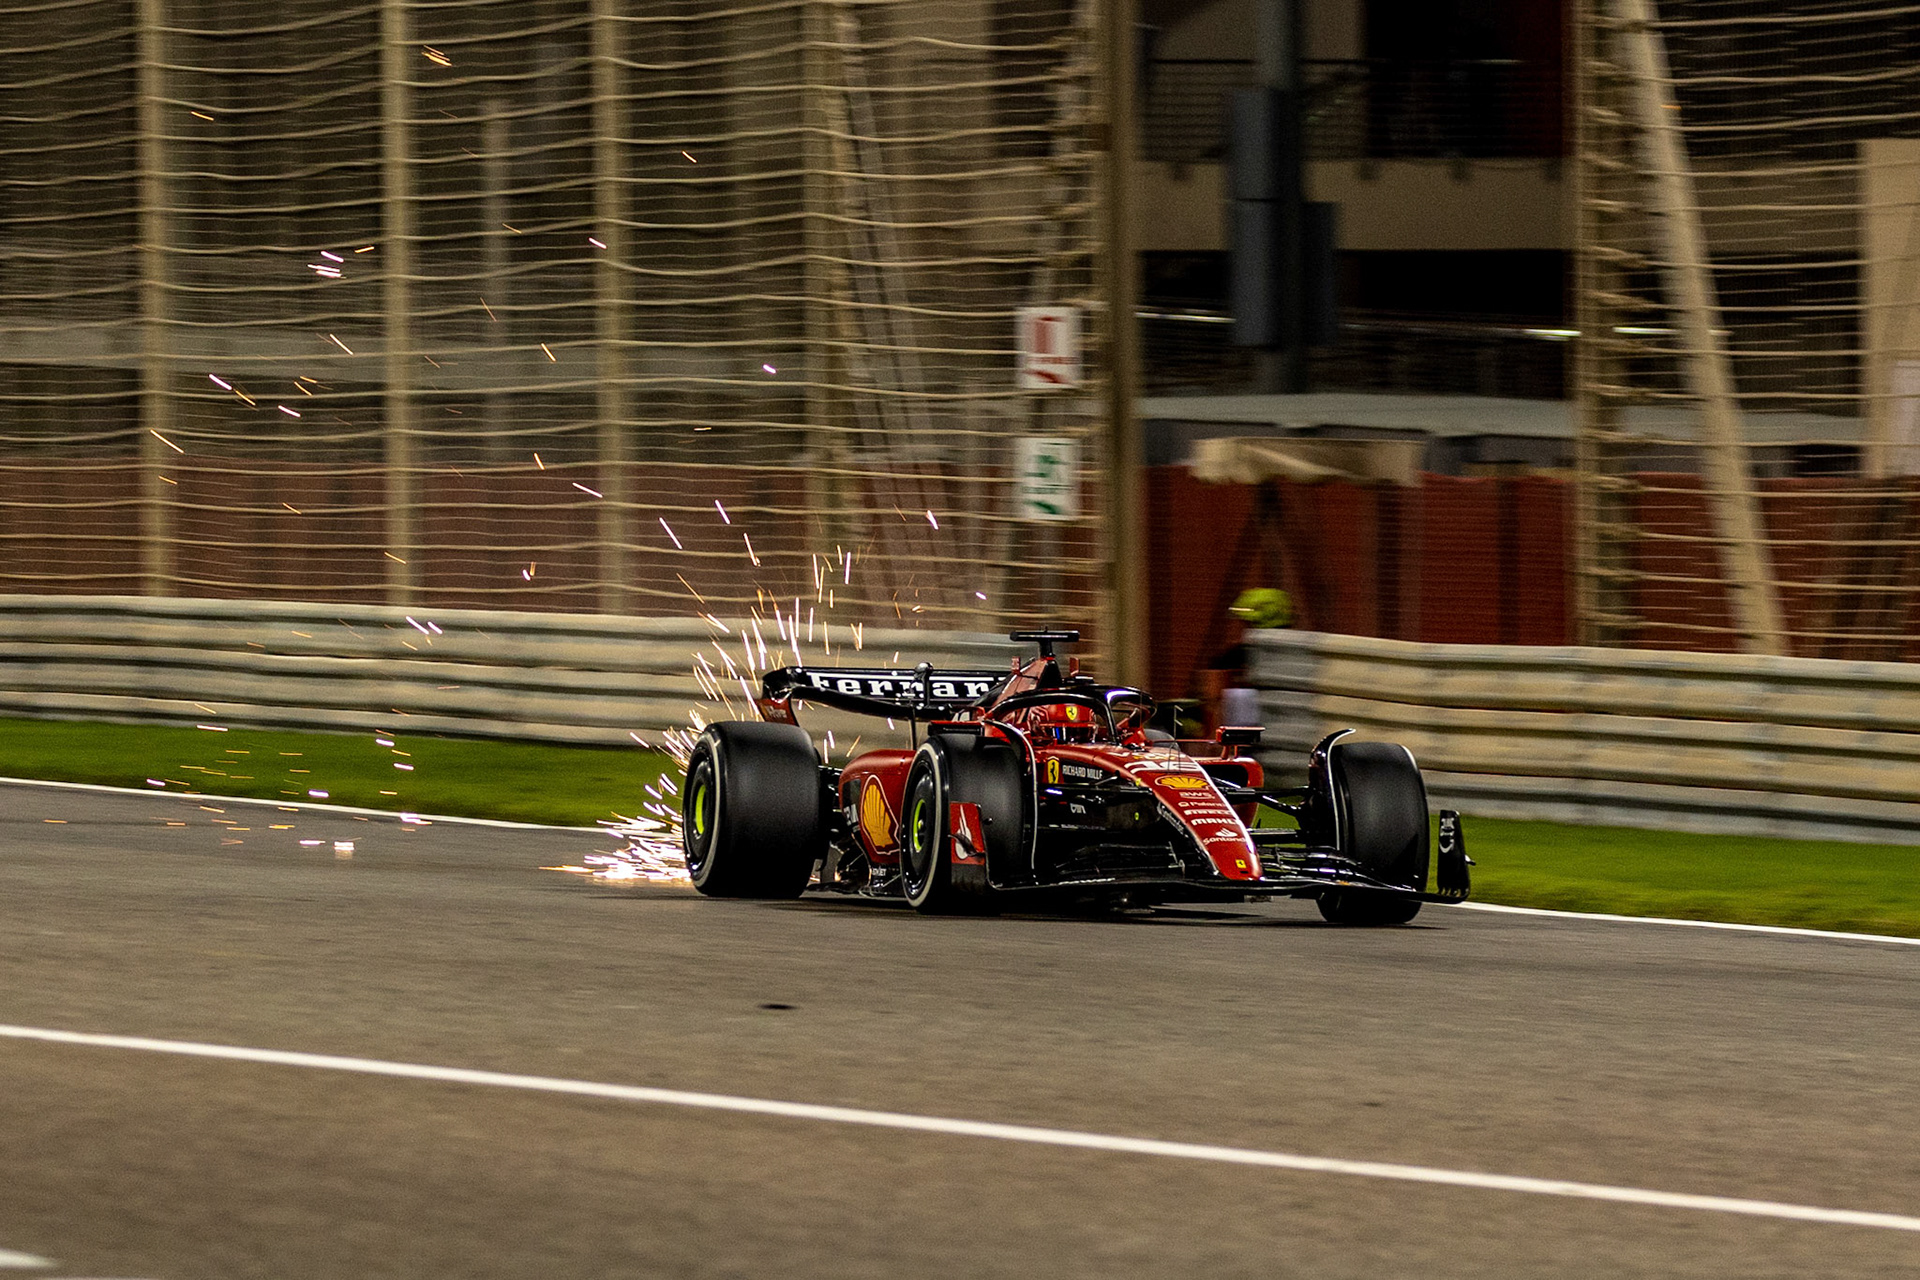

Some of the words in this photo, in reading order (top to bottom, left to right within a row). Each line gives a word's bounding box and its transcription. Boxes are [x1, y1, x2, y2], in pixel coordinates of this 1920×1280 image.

[806, 672, 1004, 698] Ferrar
[1062, 764, 1086, 778] RICHARD
[1087, 768, 1103, 780] MILLE
[1191, 818, 1238, 826] MAHL
[1203, 836, 1246, 846] Santand
